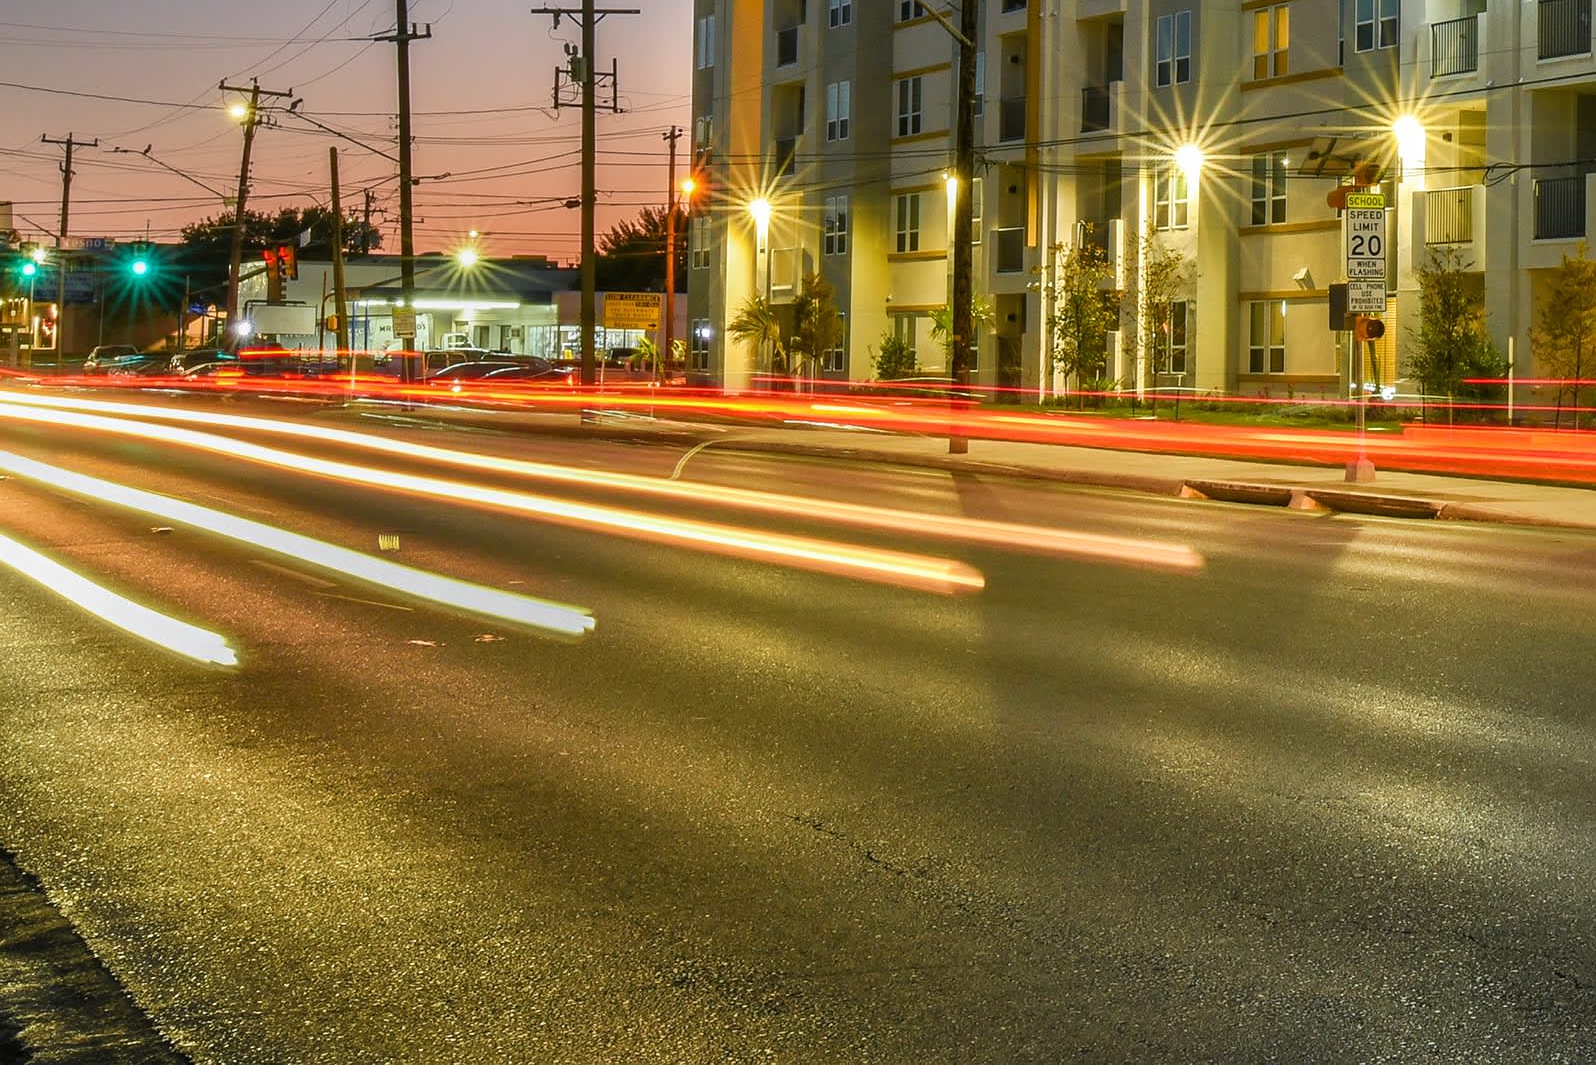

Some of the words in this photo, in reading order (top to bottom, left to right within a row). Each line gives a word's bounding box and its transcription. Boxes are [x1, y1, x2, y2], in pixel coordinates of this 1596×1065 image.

[1348, 196, 1383, 206] SCHOOL
[1350, 210, 1383, 220] SPEED
[1353, 222, 1380, 232] LIMIT
[61, 238, 102, 248] resno
[1351, 235, 1382, 256] 20
[1356, 260, 1377, 268] WHEN
[1349, 268, 1384, 276] FLASHING
